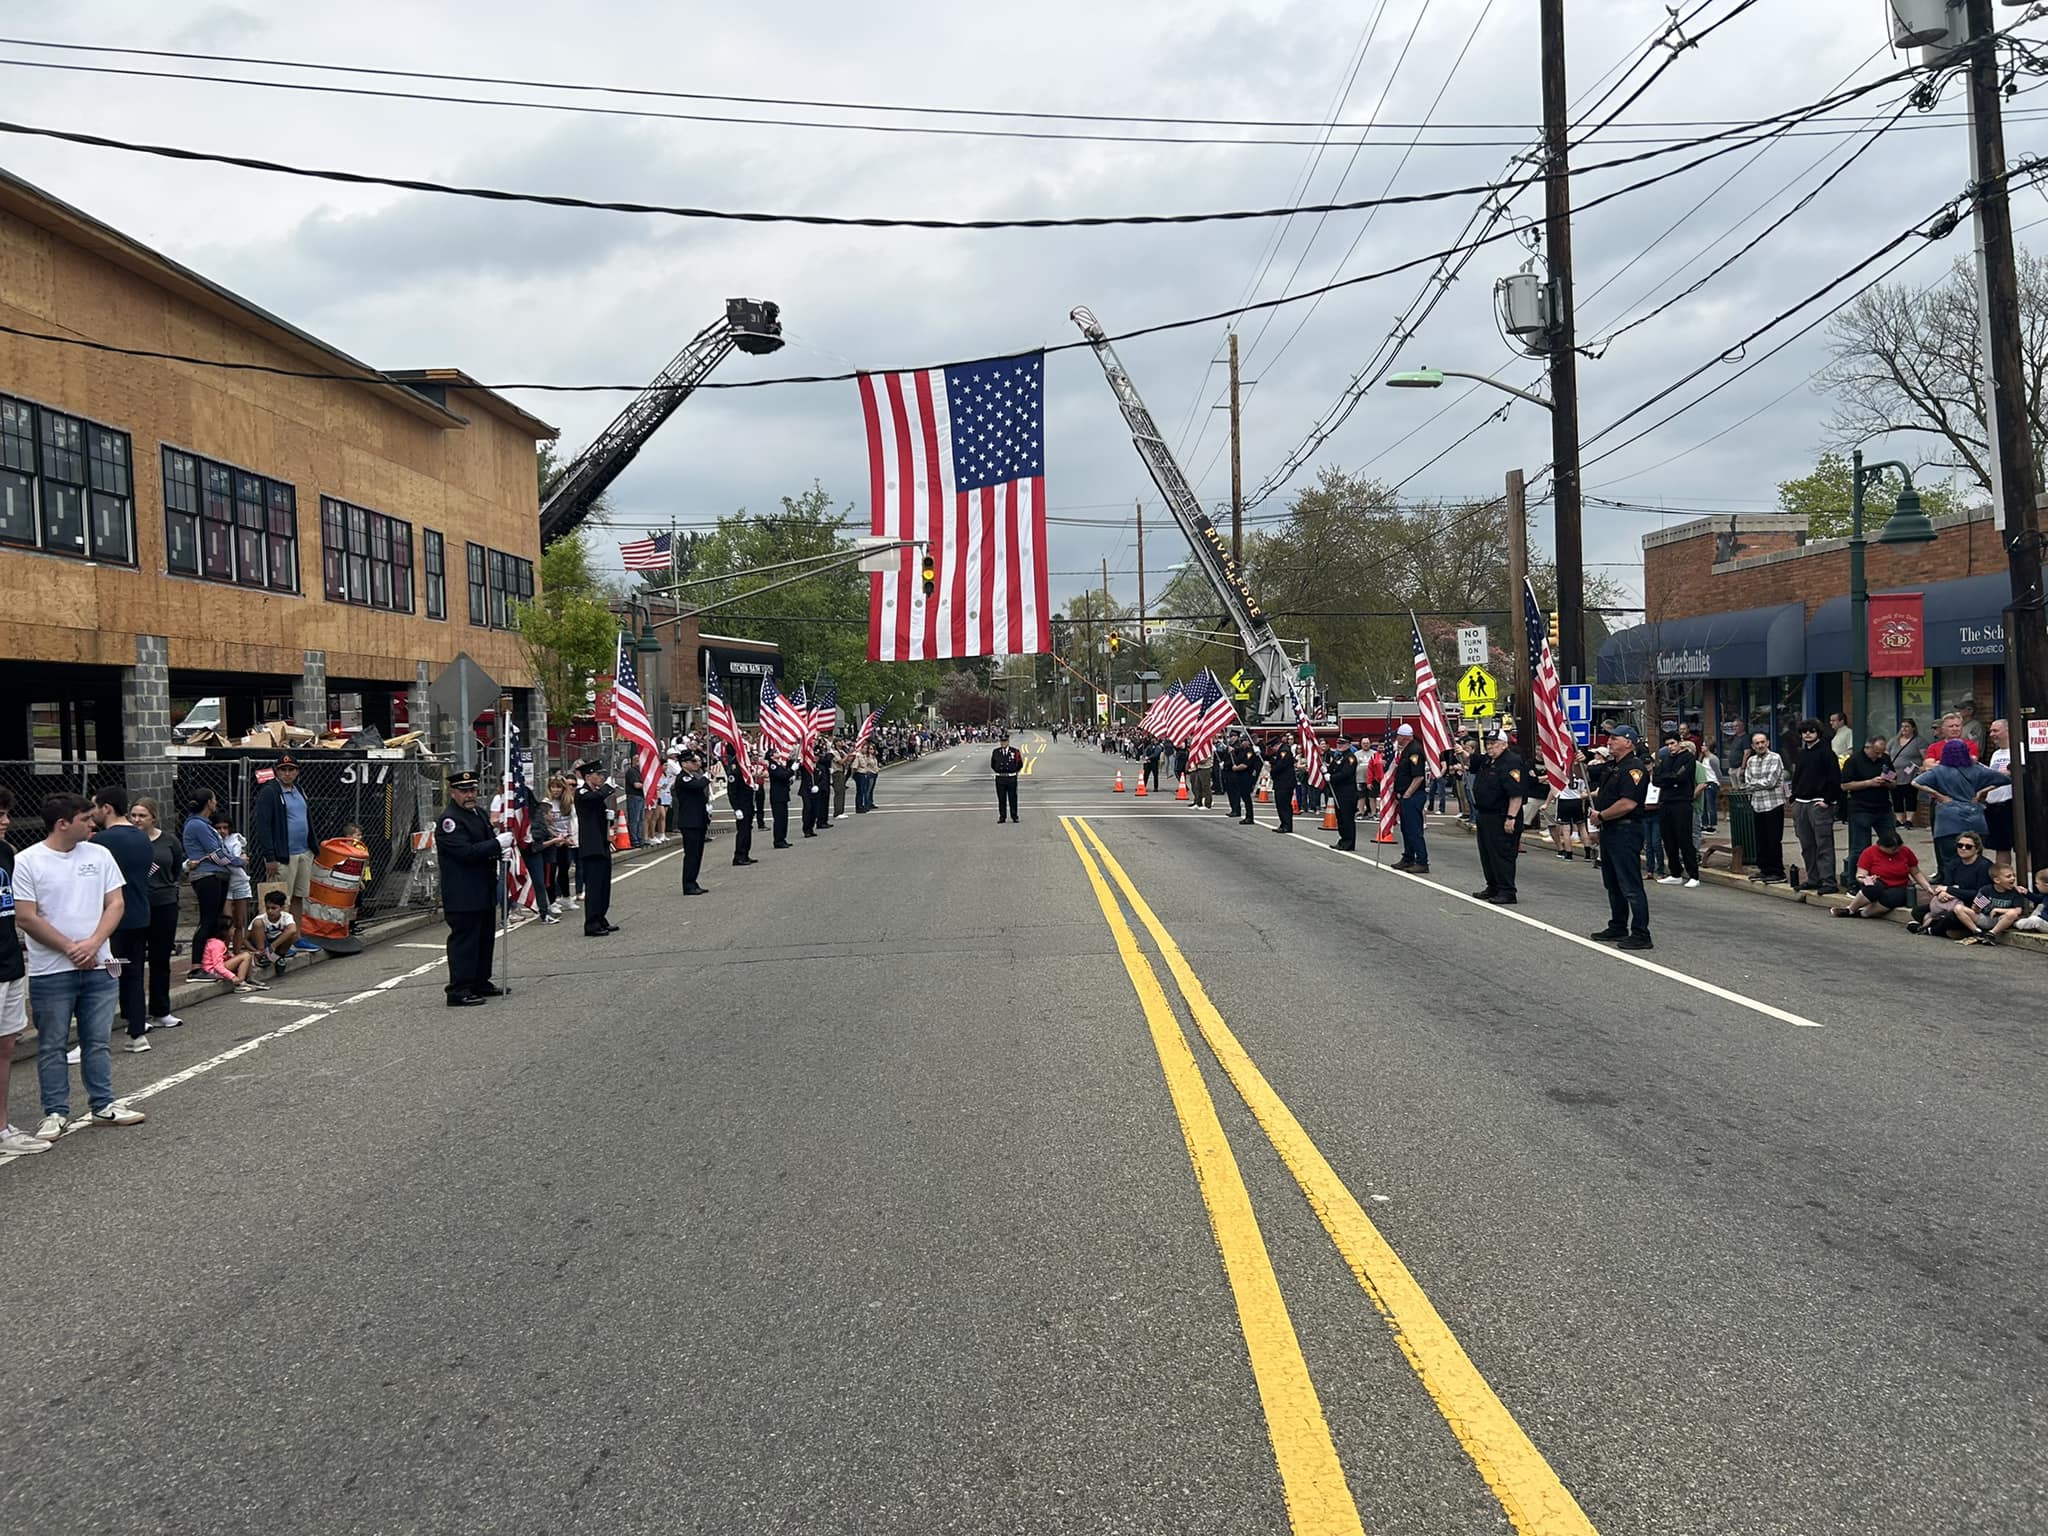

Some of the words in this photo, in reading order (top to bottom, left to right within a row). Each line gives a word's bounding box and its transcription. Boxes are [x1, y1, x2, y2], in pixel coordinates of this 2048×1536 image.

[1204, 526, 1236, 570] RIVER
[1236, 577, 1262, 618] EDGE
[1464, 630, 1479, 638] NO
[1960, 626, 1981, 642] The
[1468, 647, 1479, 655] ON
[1562, 687, 1587, 720] H
[340, 762, 390, 784] 317
